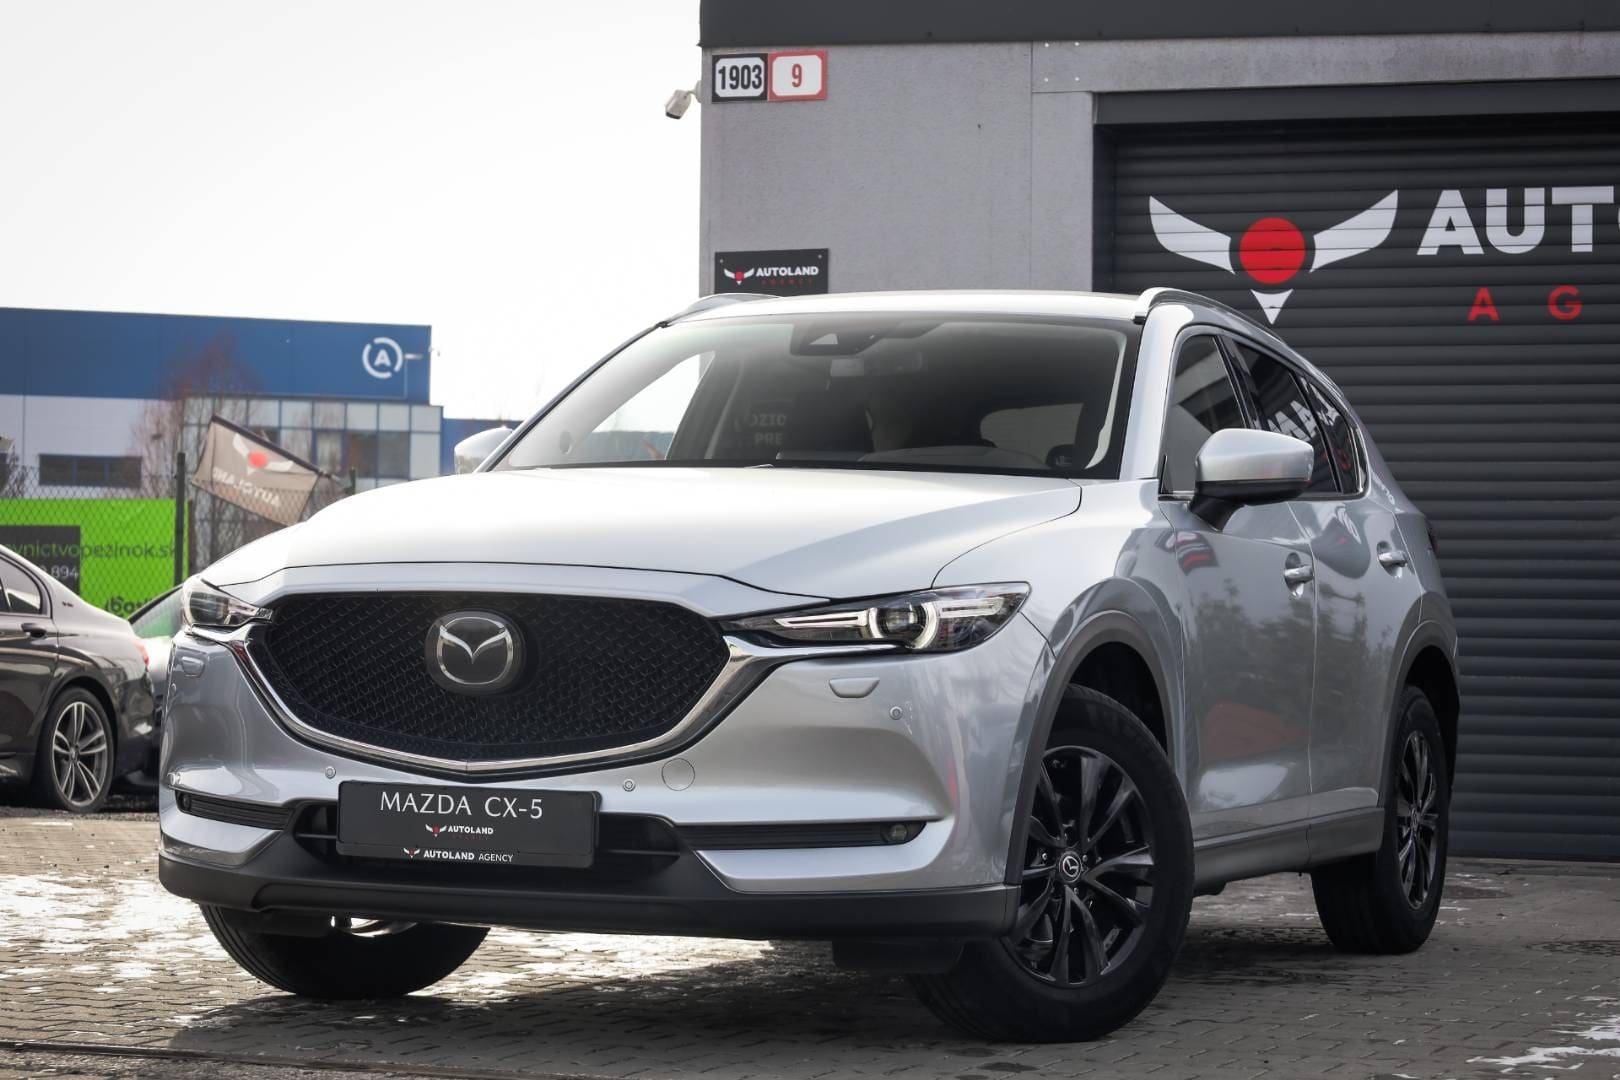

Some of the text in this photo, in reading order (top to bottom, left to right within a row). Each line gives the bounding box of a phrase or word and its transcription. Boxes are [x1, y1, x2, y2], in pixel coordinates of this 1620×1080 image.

[718, 64, 763, 90] 1903
[791, 63, 803, 88] 9
[1416, 185, 1620, 256] AUT
[755, 266, 819, 277] AUTOLAND
[380, 791, 543, 819] MAZDA CX-5
[448, 825, 494, 835] AUTOLAND
[423, 850, 514, 863] AUTOLAND AGENCY
